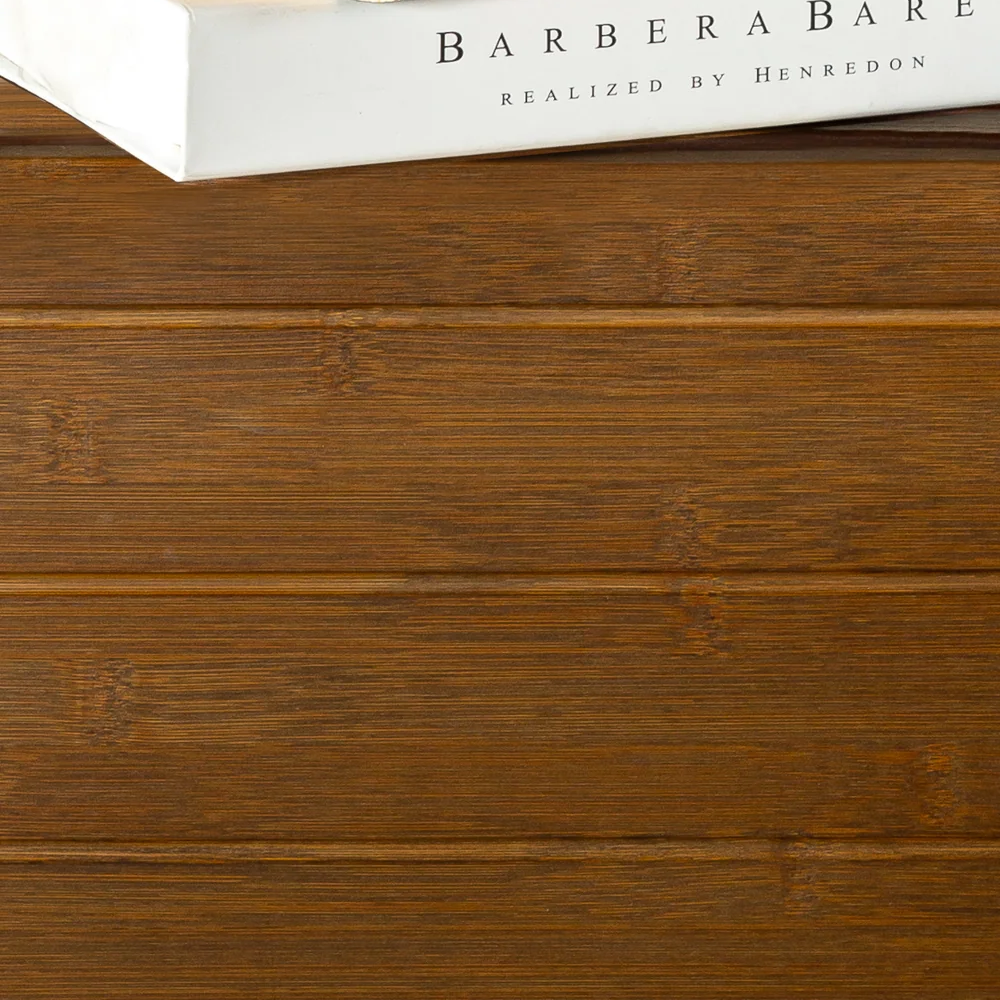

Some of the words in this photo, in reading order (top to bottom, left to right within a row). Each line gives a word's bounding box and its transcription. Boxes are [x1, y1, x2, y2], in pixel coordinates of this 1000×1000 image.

[435, 9, 771, 65] BARBERA
[500, 78, 663, 106] REALIZED
[691, 73, 726, 90] BY
[753, 55, 927, 84] HENREDON
